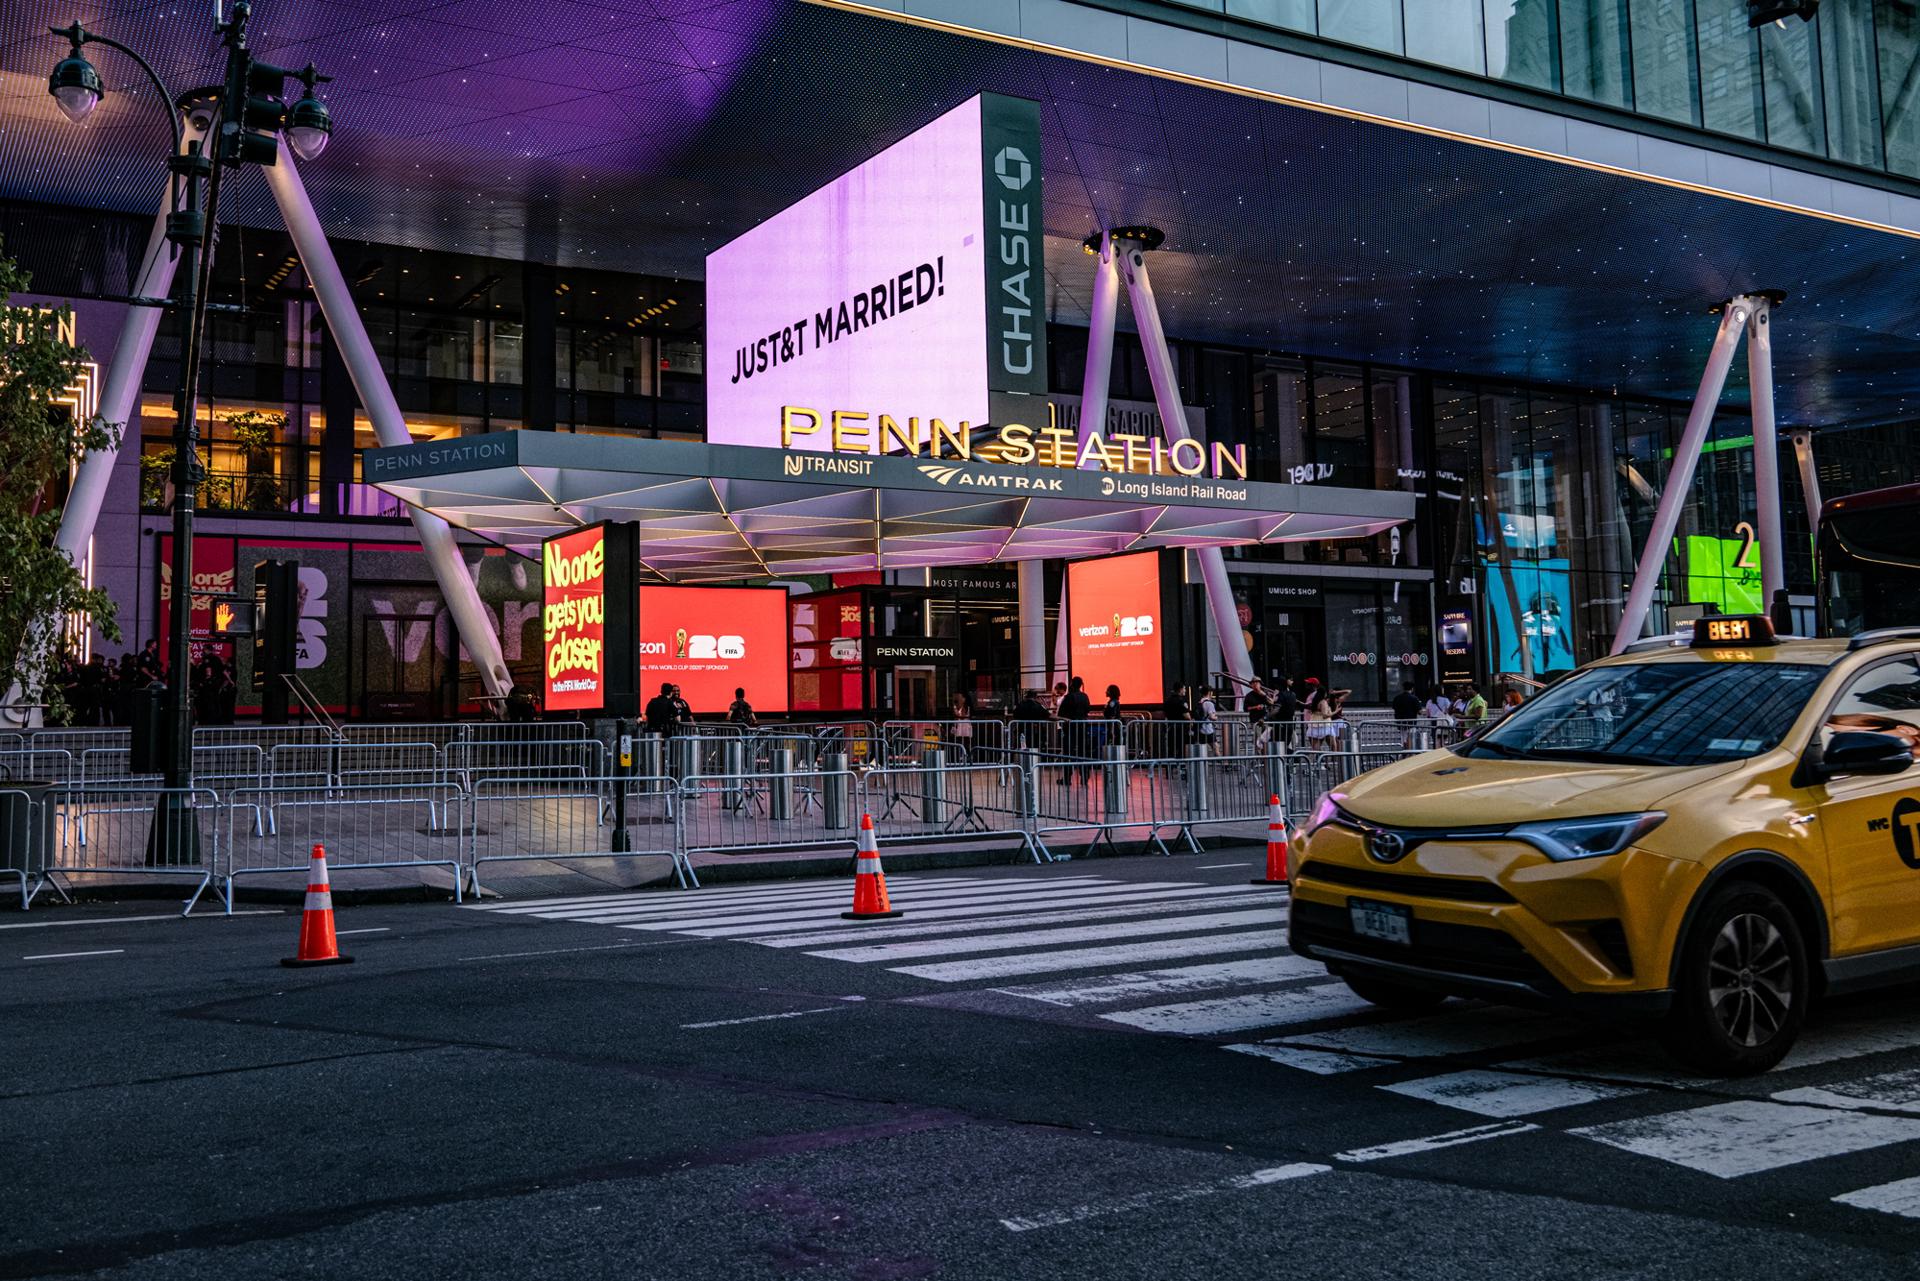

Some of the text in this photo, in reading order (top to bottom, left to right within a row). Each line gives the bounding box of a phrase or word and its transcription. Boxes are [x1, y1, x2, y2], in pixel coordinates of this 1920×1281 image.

[1000, 200, 1033, 375] CHASE
[731, 256, 944, 384] JUST&T MARRIED!
[781, 406, 1247, 479] PENN STATION
[375, 443, 505, 471] PENN STATION
[804, 457, 873, 475] TRANSIT
[958, 474, 1063, 491] AMTRAK
[1117, 481, 1148, 498] Long
[1151, 482, 1188, 497] Island
[1191, 484, 1213, 499] Rail
[1216, 486, 1247, 501] Road
[1736, 522, 1756, 567] 2
[544, 539, 604, 587] No one
[933, 580, 958, 588] MOST
[962, 580, 1001, 589] FAMOUS
[1268, 587, 1317, 596] UMUSIC SHOP
[544, 594, 604, 641] gets you
[1079, 625, 1109, 637] verizon
[549, 631, 601, 678] closer
[689, 635, 745, 659] 26
[877, 648, 954, 656] PENN STATION
[1867, 817, 1889, 832] NYC
